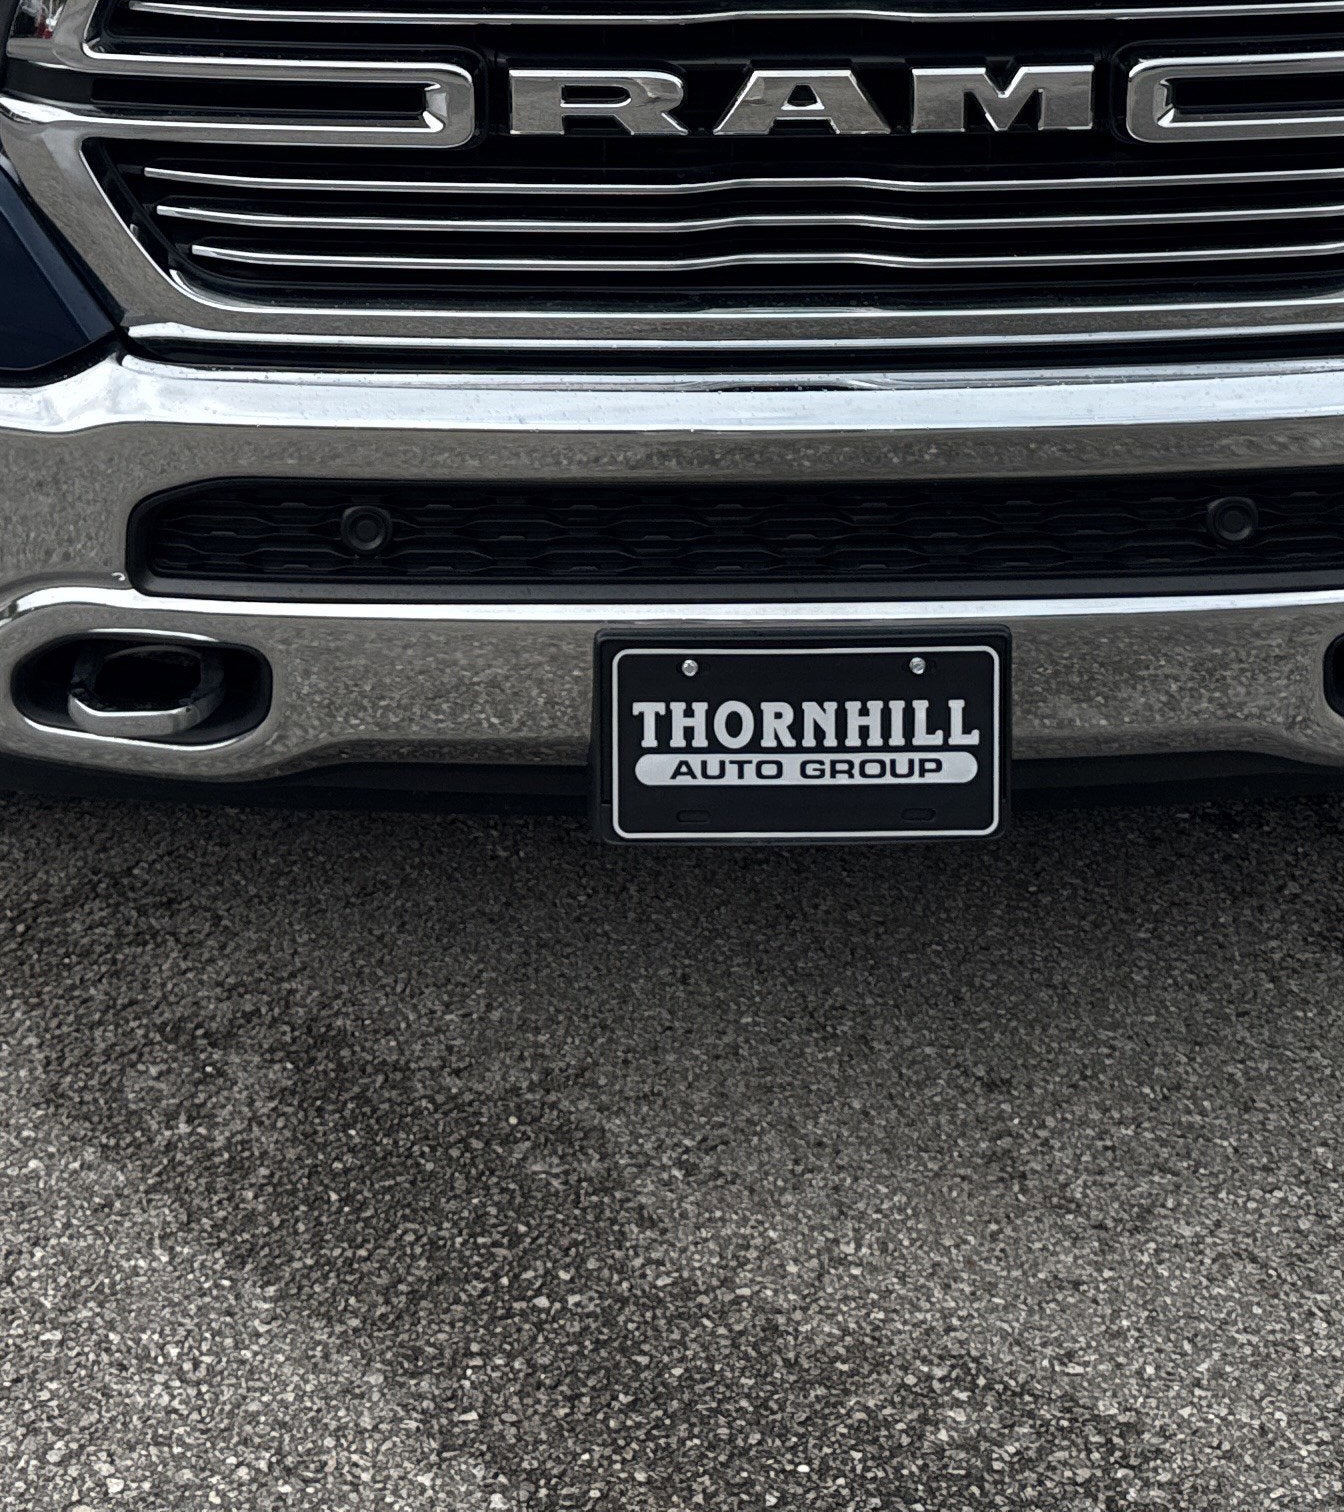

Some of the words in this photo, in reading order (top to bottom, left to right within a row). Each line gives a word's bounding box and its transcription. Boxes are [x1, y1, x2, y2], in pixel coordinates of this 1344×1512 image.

[509, 65, 1096, 136] RAM
[631, 699, 981, 750] THORNHILL
[669, 759, 783, 780] AUTO
[799, 757, 943, 779] GROUP
